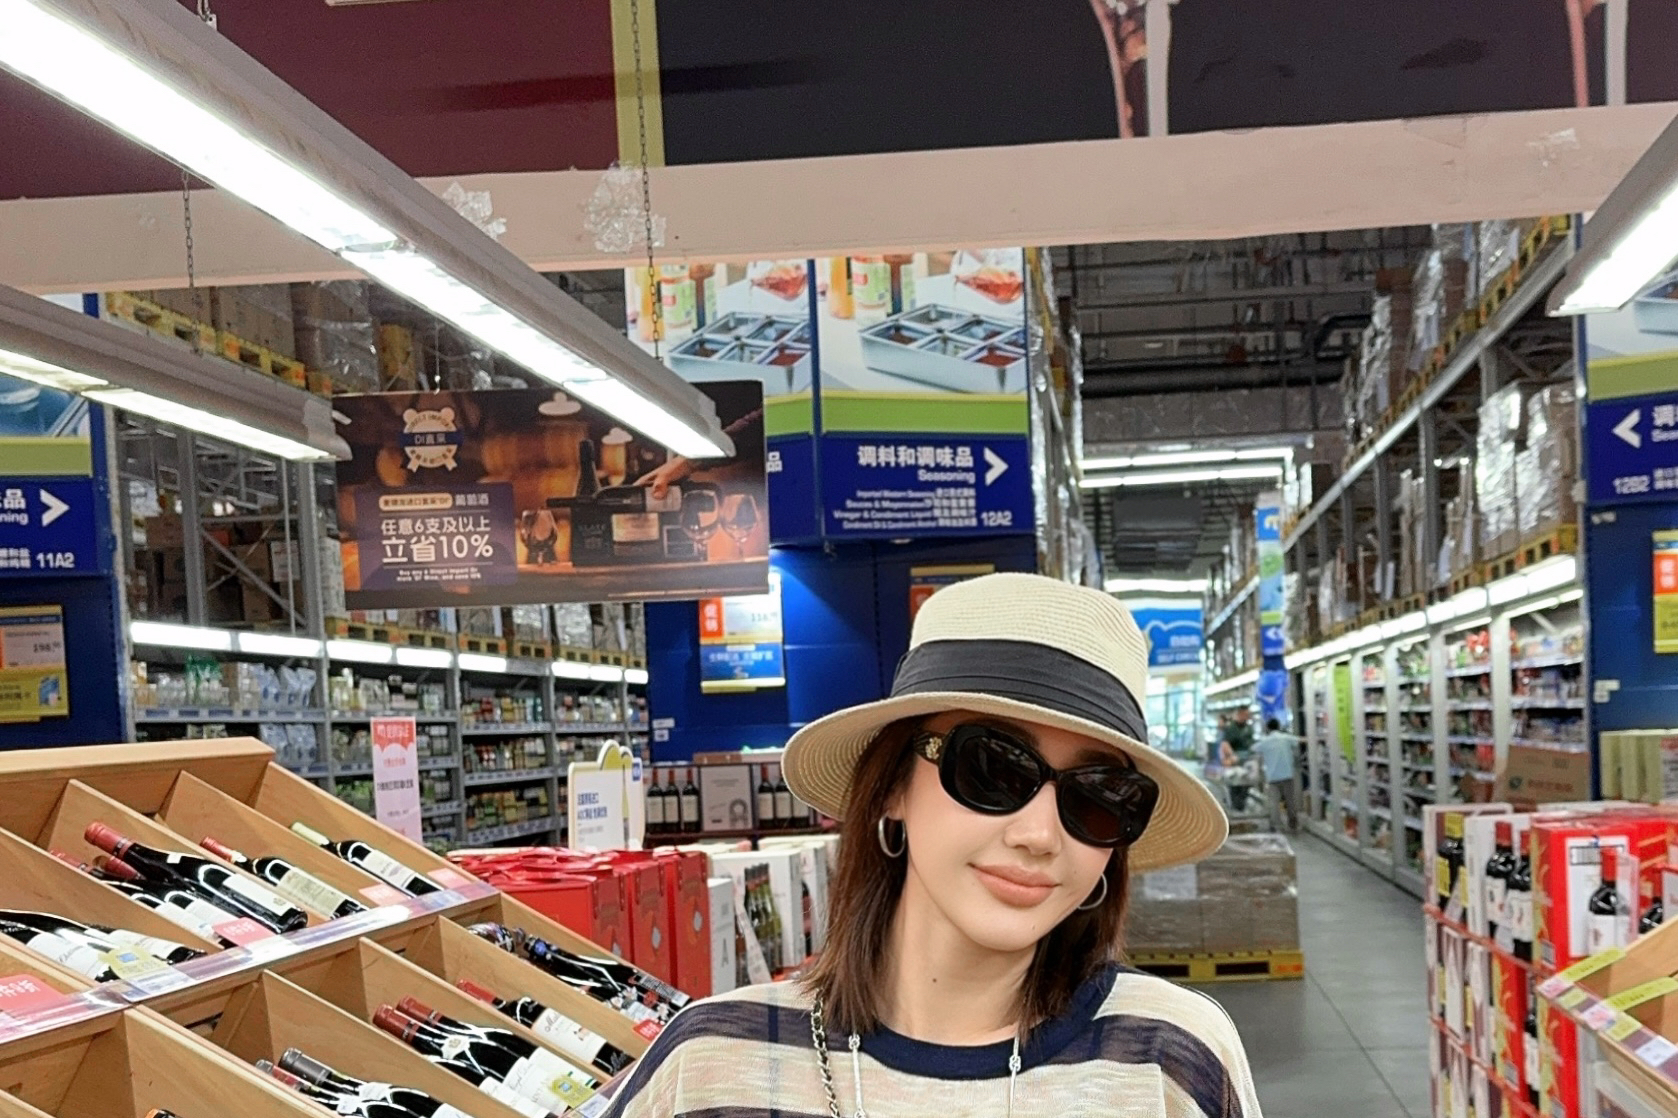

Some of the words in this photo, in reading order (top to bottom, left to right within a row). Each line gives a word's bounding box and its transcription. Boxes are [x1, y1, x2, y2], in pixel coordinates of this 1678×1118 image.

[857, 445, 975, 468] 调料和调味品
[917, 469, 976, 485] Seasoning
[0, 488, 26, 510] 品
[381, 515, 492, 536] 任意6支及以上
[381, 533, 494, 563] 立省10%
[36, 551, 76, 569] 11A2
